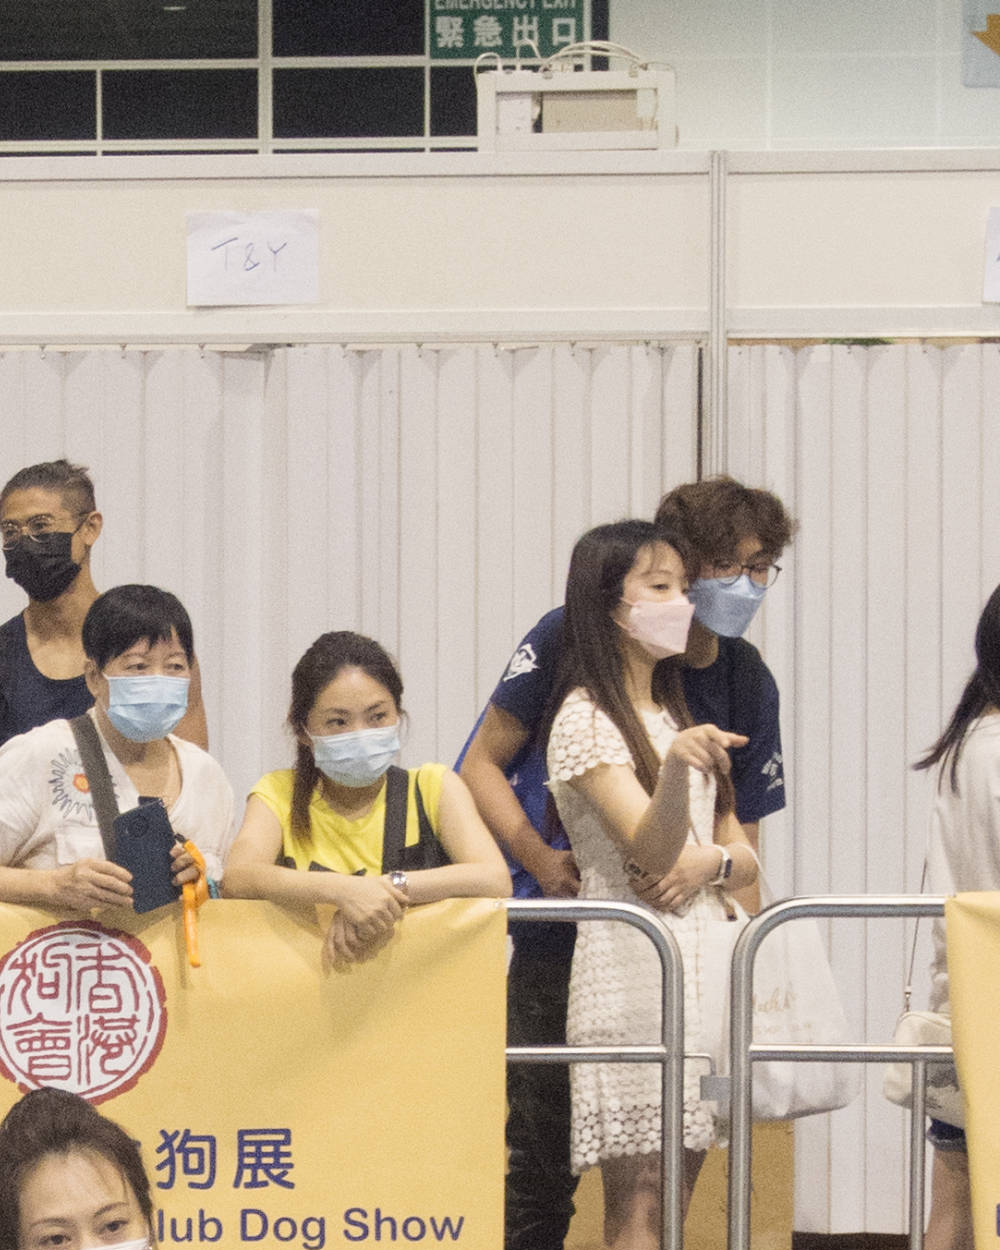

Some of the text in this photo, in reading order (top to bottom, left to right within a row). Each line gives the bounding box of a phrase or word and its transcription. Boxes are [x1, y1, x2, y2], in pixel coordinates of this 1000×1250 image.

[435, 15, 577, 48] 緊急出口
[210, 237, 288, 272] T&Y
[156, 1208, 224, 1244] lub
[342, 1207, 466, 1242] Show
